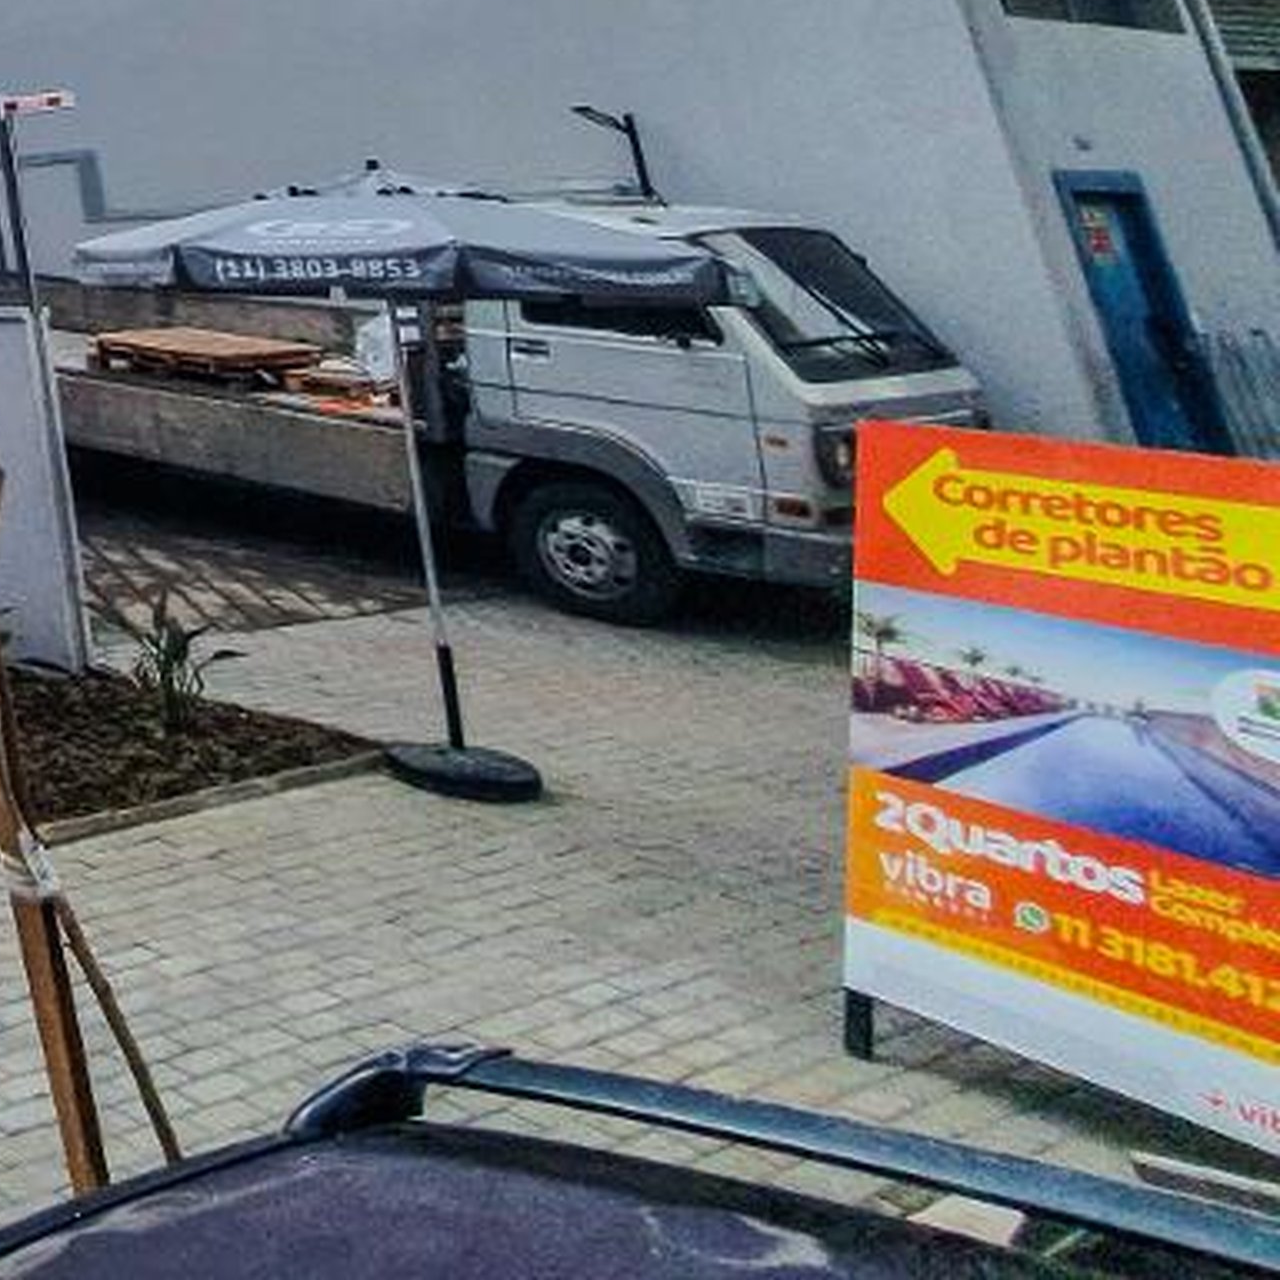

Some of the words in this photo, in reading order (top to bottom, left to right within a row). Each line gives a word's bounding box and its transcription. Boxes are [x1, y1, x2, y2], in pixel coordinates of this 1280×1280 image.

[933, 473, 1224, 542] Corretores
[973, 518, 1038, 555] de
[1048, 531, 1273, 592] plantão
[880, 850, 992, 909] vibra
